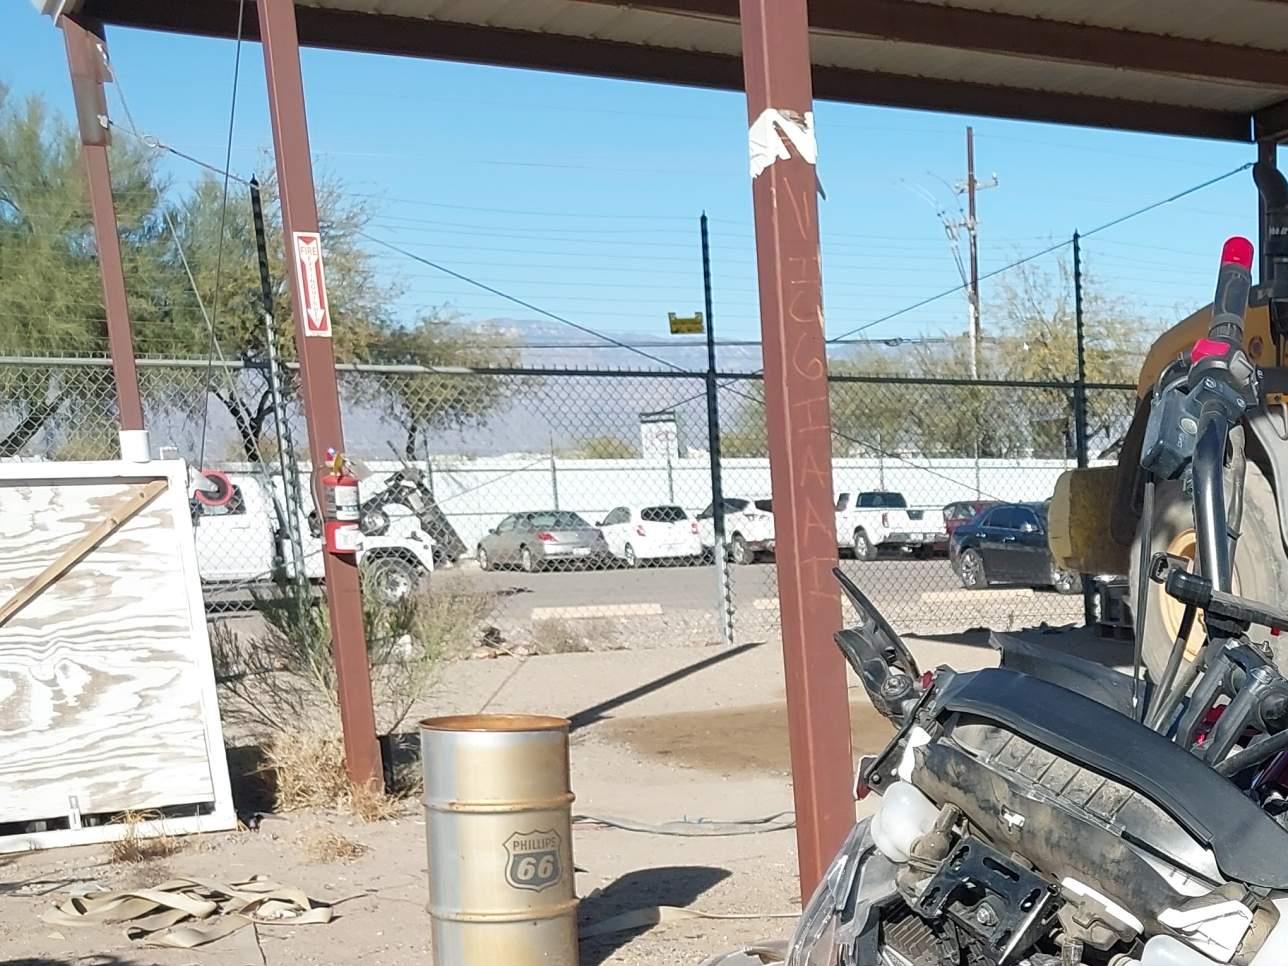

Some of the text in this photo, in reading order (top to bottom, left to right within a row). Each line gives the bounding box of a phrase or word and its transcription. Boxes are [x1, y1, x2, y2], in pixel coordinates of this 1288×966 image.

[300, 246, 318, 256] FIRE
[513, 837, 556, 850] PHILLIPS
[517, 857, 554, 880] 66
